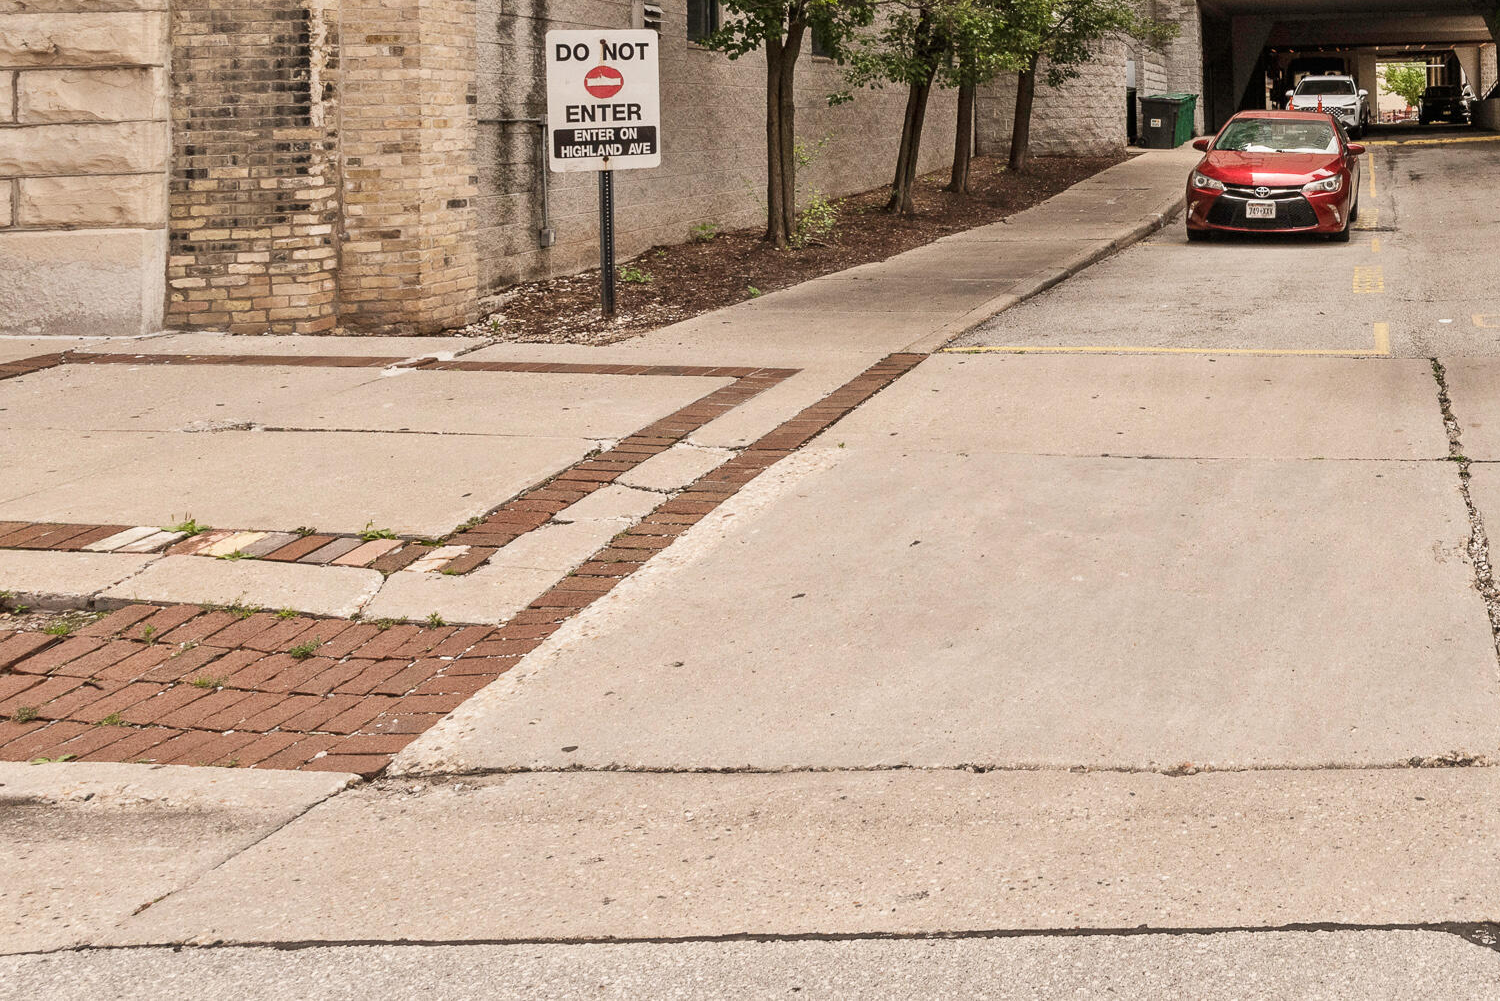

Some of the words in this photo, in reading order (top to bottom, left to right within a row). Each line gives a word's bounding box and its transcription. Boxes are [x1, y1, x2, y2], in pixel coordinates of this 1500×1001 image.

[555, 43, 590, 62] DO
[602, 42, 649, 61] NOT
[565, 103, 642, 123] ENTER
[574, 129, 615, 142] ENTER
[620, 127, 638, 140] ON
[561, 143, 623, 158] HIGHLAND
[628, 142, 651, 154] AVE
